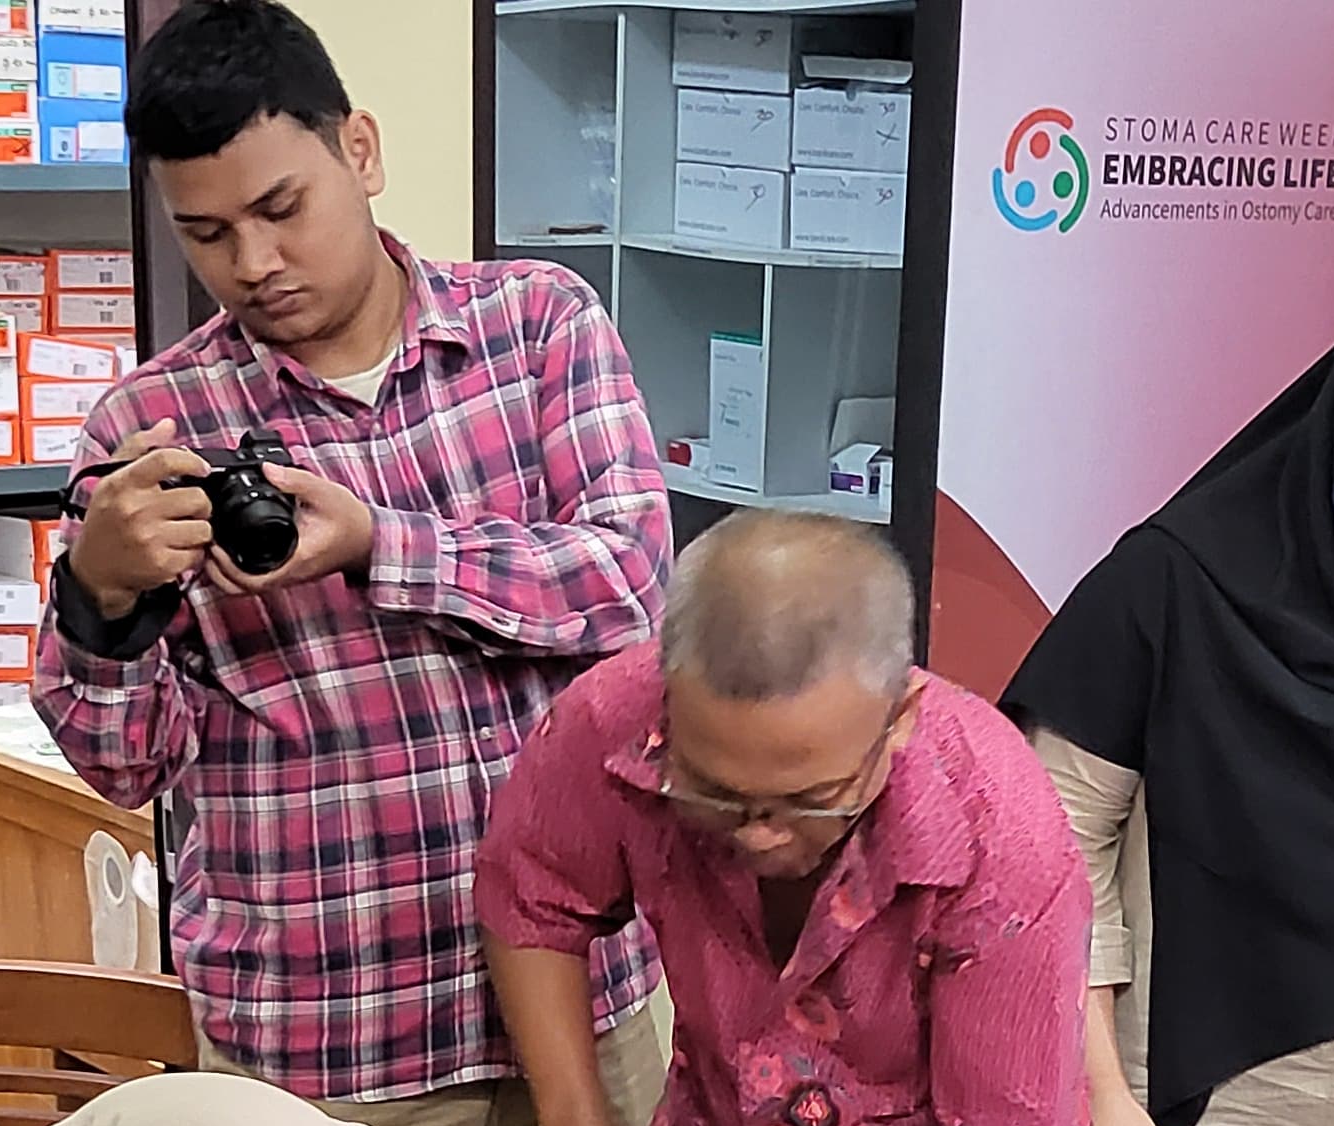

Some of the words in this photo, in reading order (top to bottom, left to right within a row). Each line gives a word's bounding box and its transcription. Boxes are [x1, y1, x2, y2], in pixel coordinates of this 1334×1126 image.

[1105, 116, 1197, 143] STOMA
[1205, 119, 1271, 146] CARE
[1102, 153, 1276, 188] EMBRACING
[1099, 198, 1220, 221] Advancements
[1223, 201, 1238, 220] in
[1241, 200, 1301, 226] Ostomy
